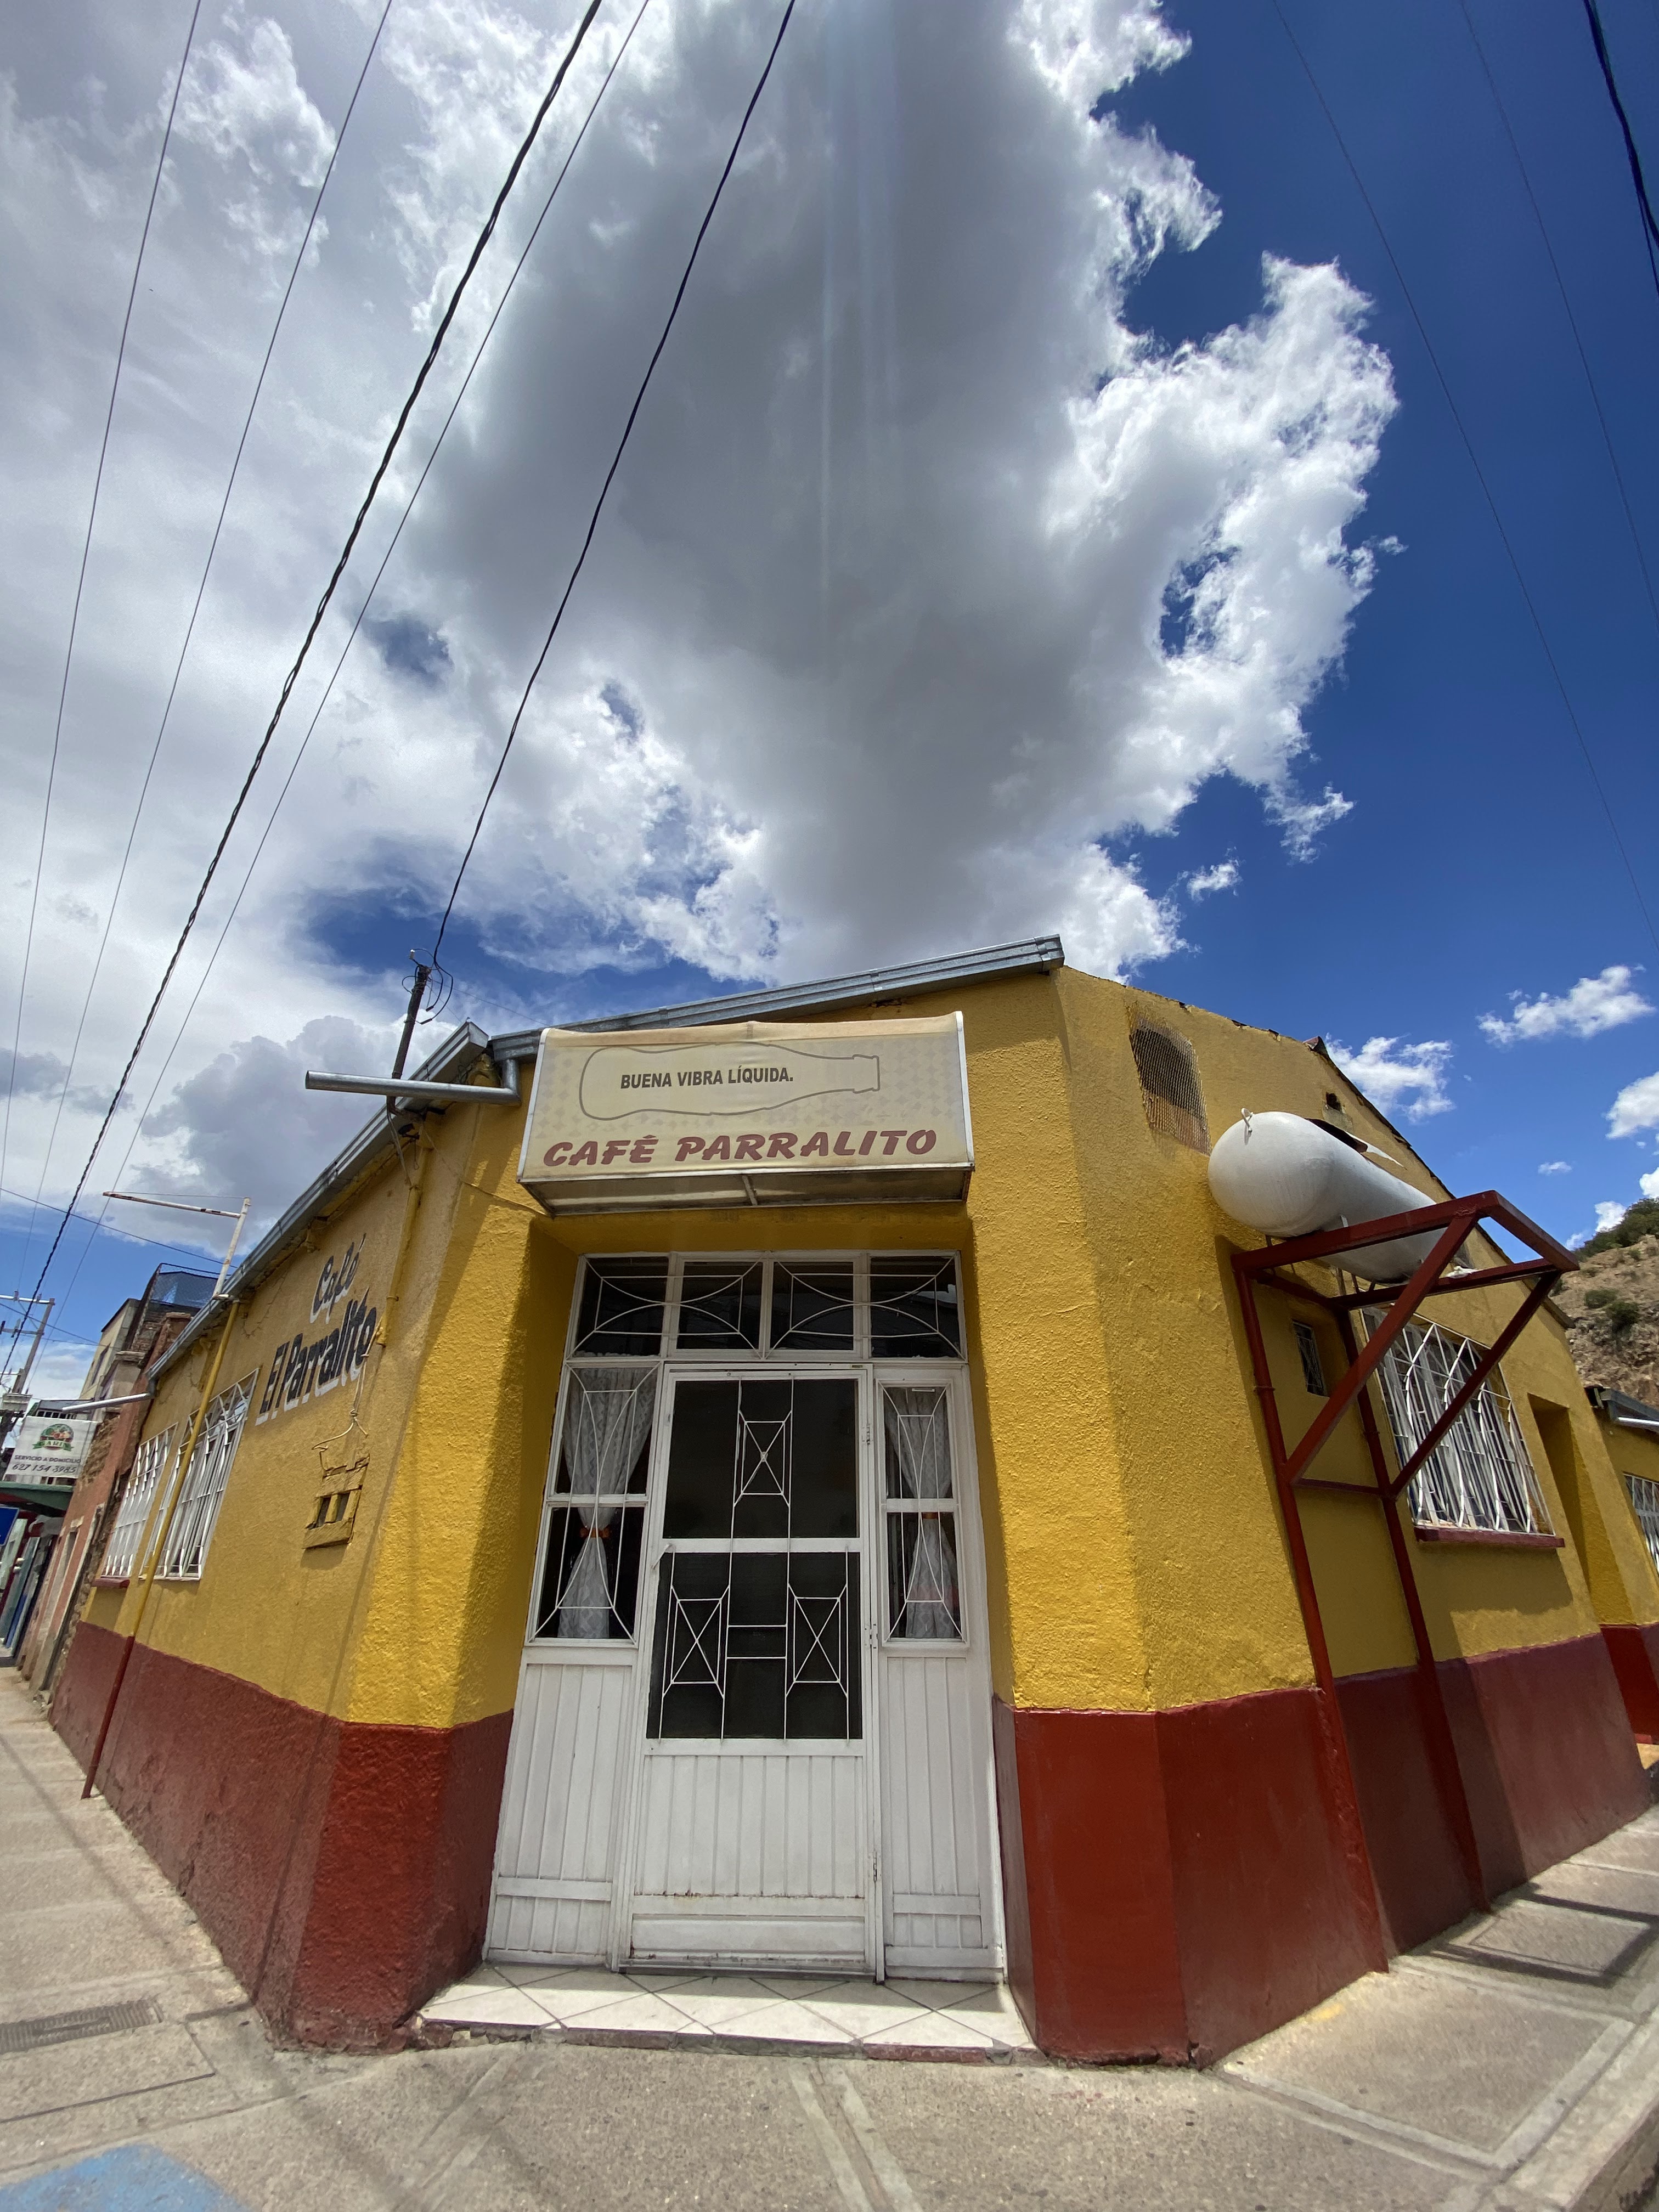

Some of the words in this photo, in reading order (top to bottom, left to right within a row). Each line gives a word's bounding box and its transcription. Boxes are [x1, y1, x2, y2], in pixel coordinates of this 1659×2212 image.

[620, 1073, 672, 1090] BUENA
[678, 1070, 723, 1087] VIBRA
[728, 1065, 793, 1084] LÍQUIDA.
[543, 1135, 659, 1167] CAFÉ
[674, 1130, 936, 1161] PARRALITO
[310, 1233, 366, 1322] Café
[256, 1341, 290, 1422] El
[272, 1288, 377, 1415] Parralito
